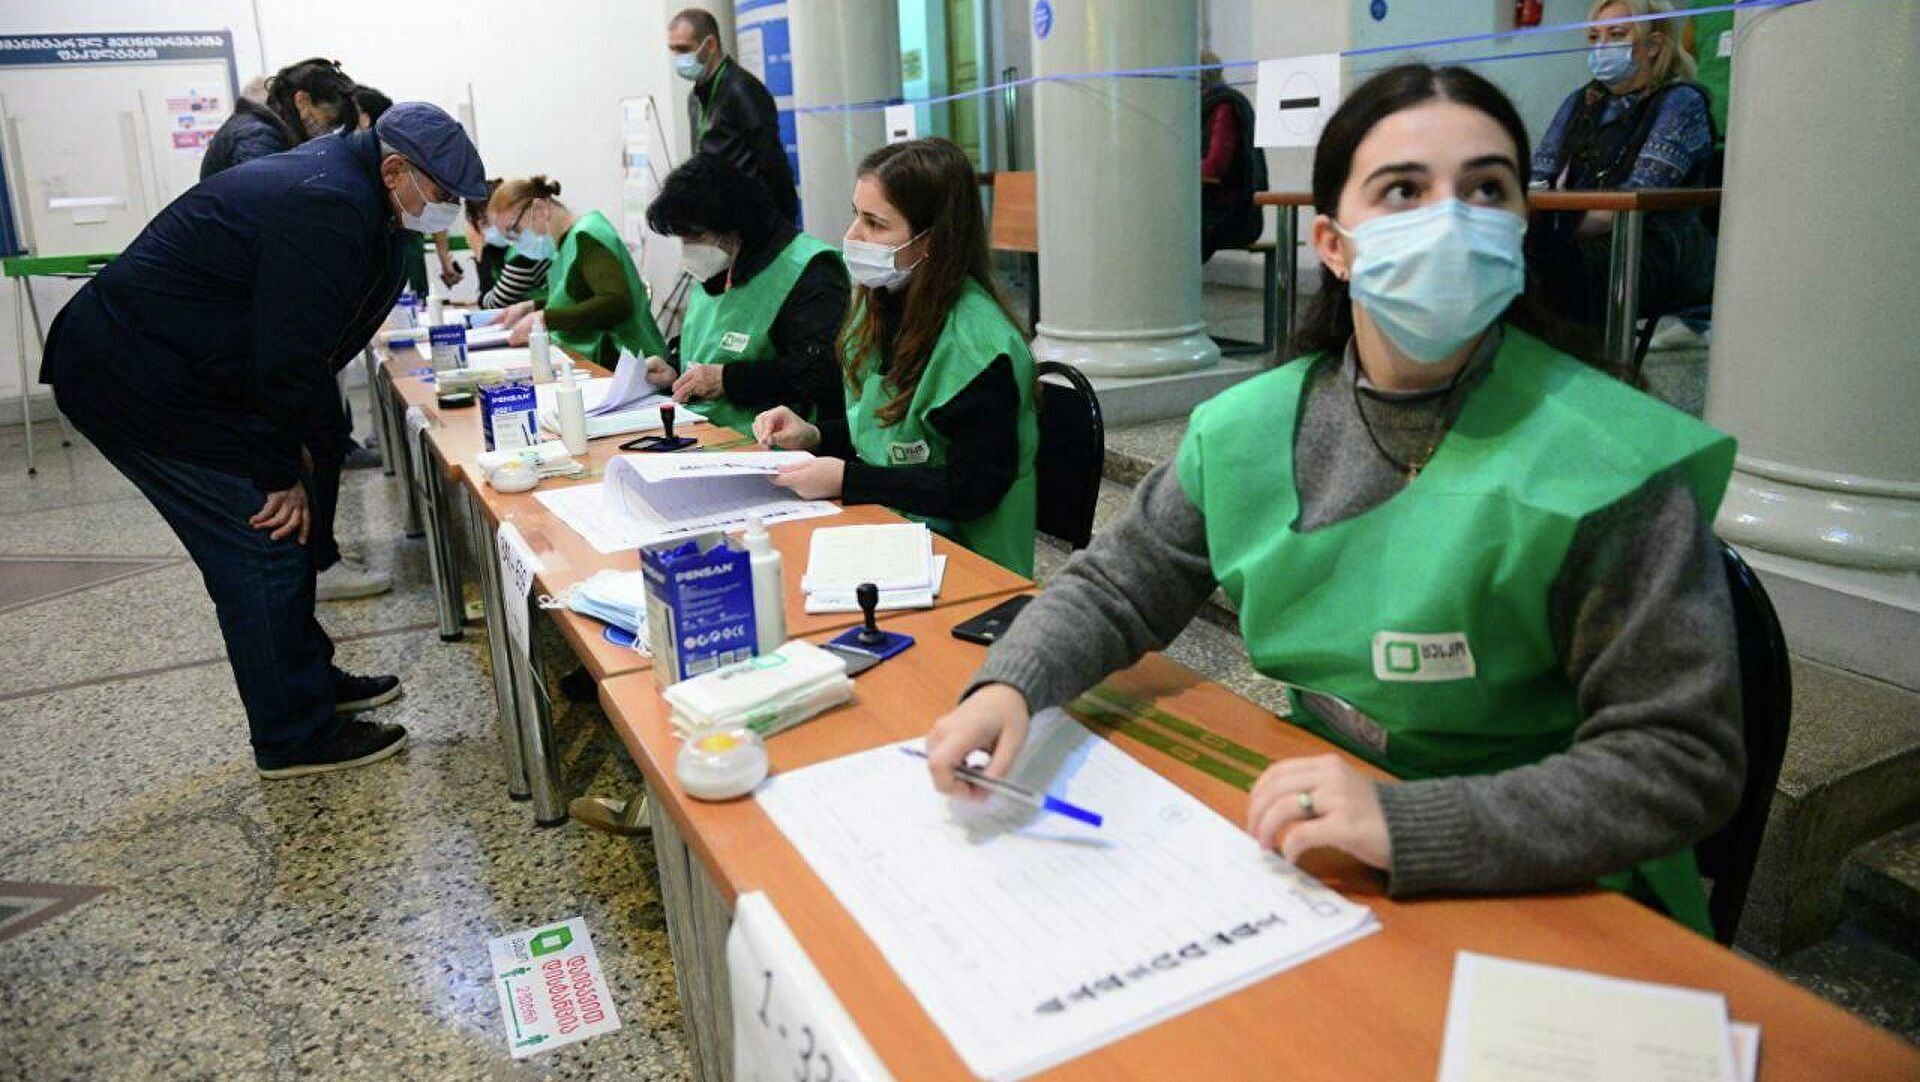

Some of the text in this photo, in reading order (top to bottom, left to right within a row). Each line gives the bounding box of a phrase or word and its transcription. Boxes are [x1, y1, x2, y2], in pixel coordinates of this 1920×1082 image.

[675, 563, 734, 582] PENSAN
[542, 959, 581, 1035] დისტანცია
[566, 955, 605, 1024] დაიცავით
